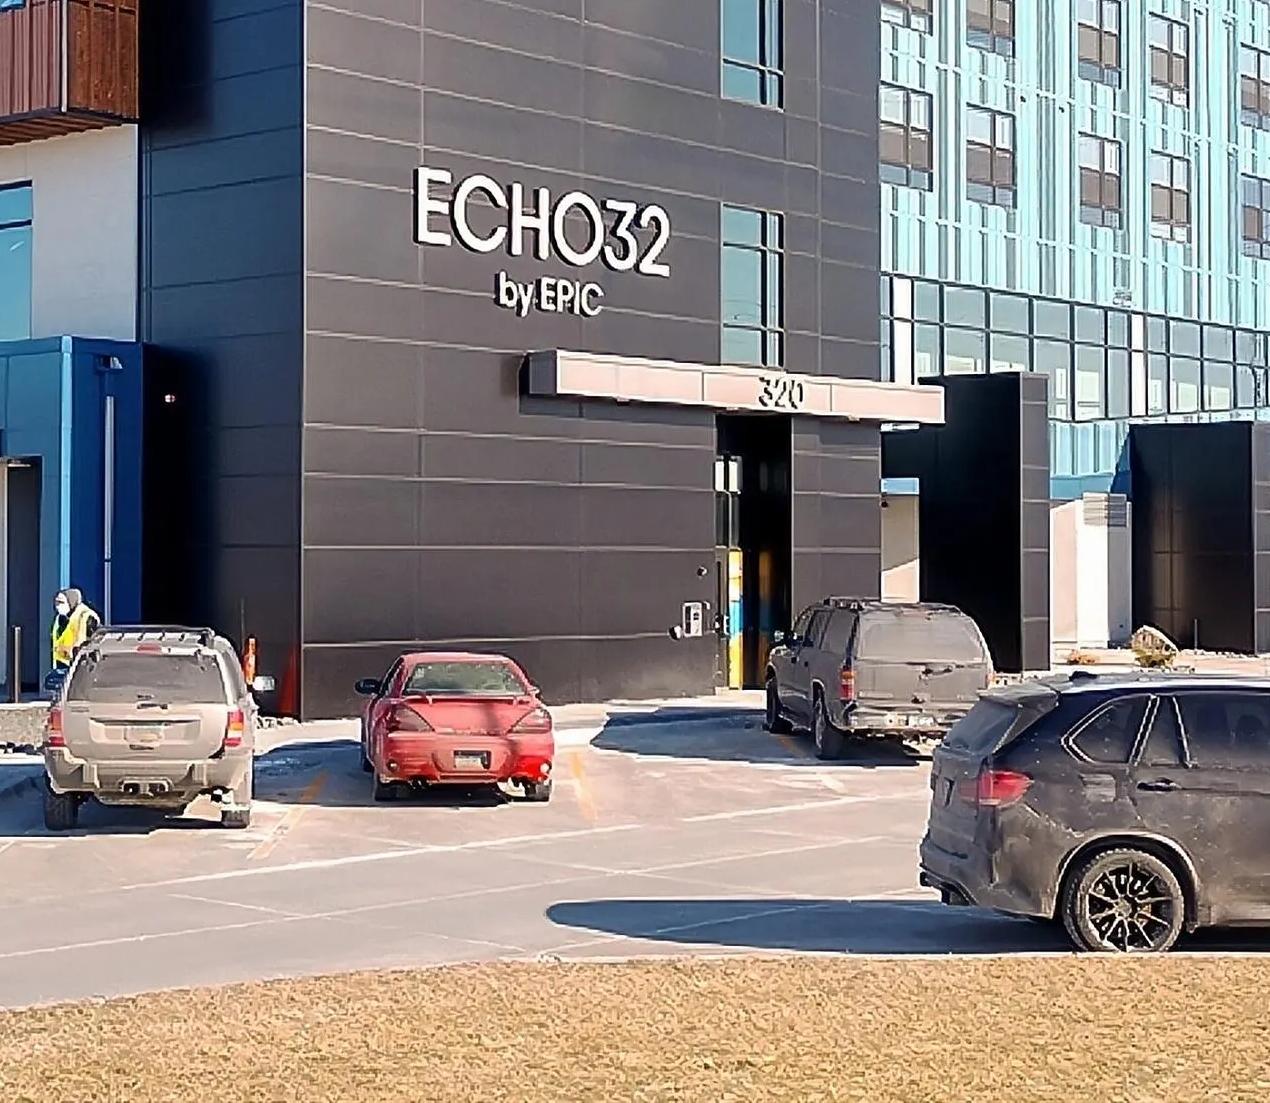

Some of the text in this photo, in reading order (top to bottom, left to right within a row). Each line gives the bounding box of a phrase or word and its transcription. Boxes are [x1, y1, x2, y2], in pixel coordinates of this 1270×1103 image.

[417, 166, 671, 277] ECHO32
[498, 271, 605, 317] by EPIC
[758, 376, 804, 409] 320
